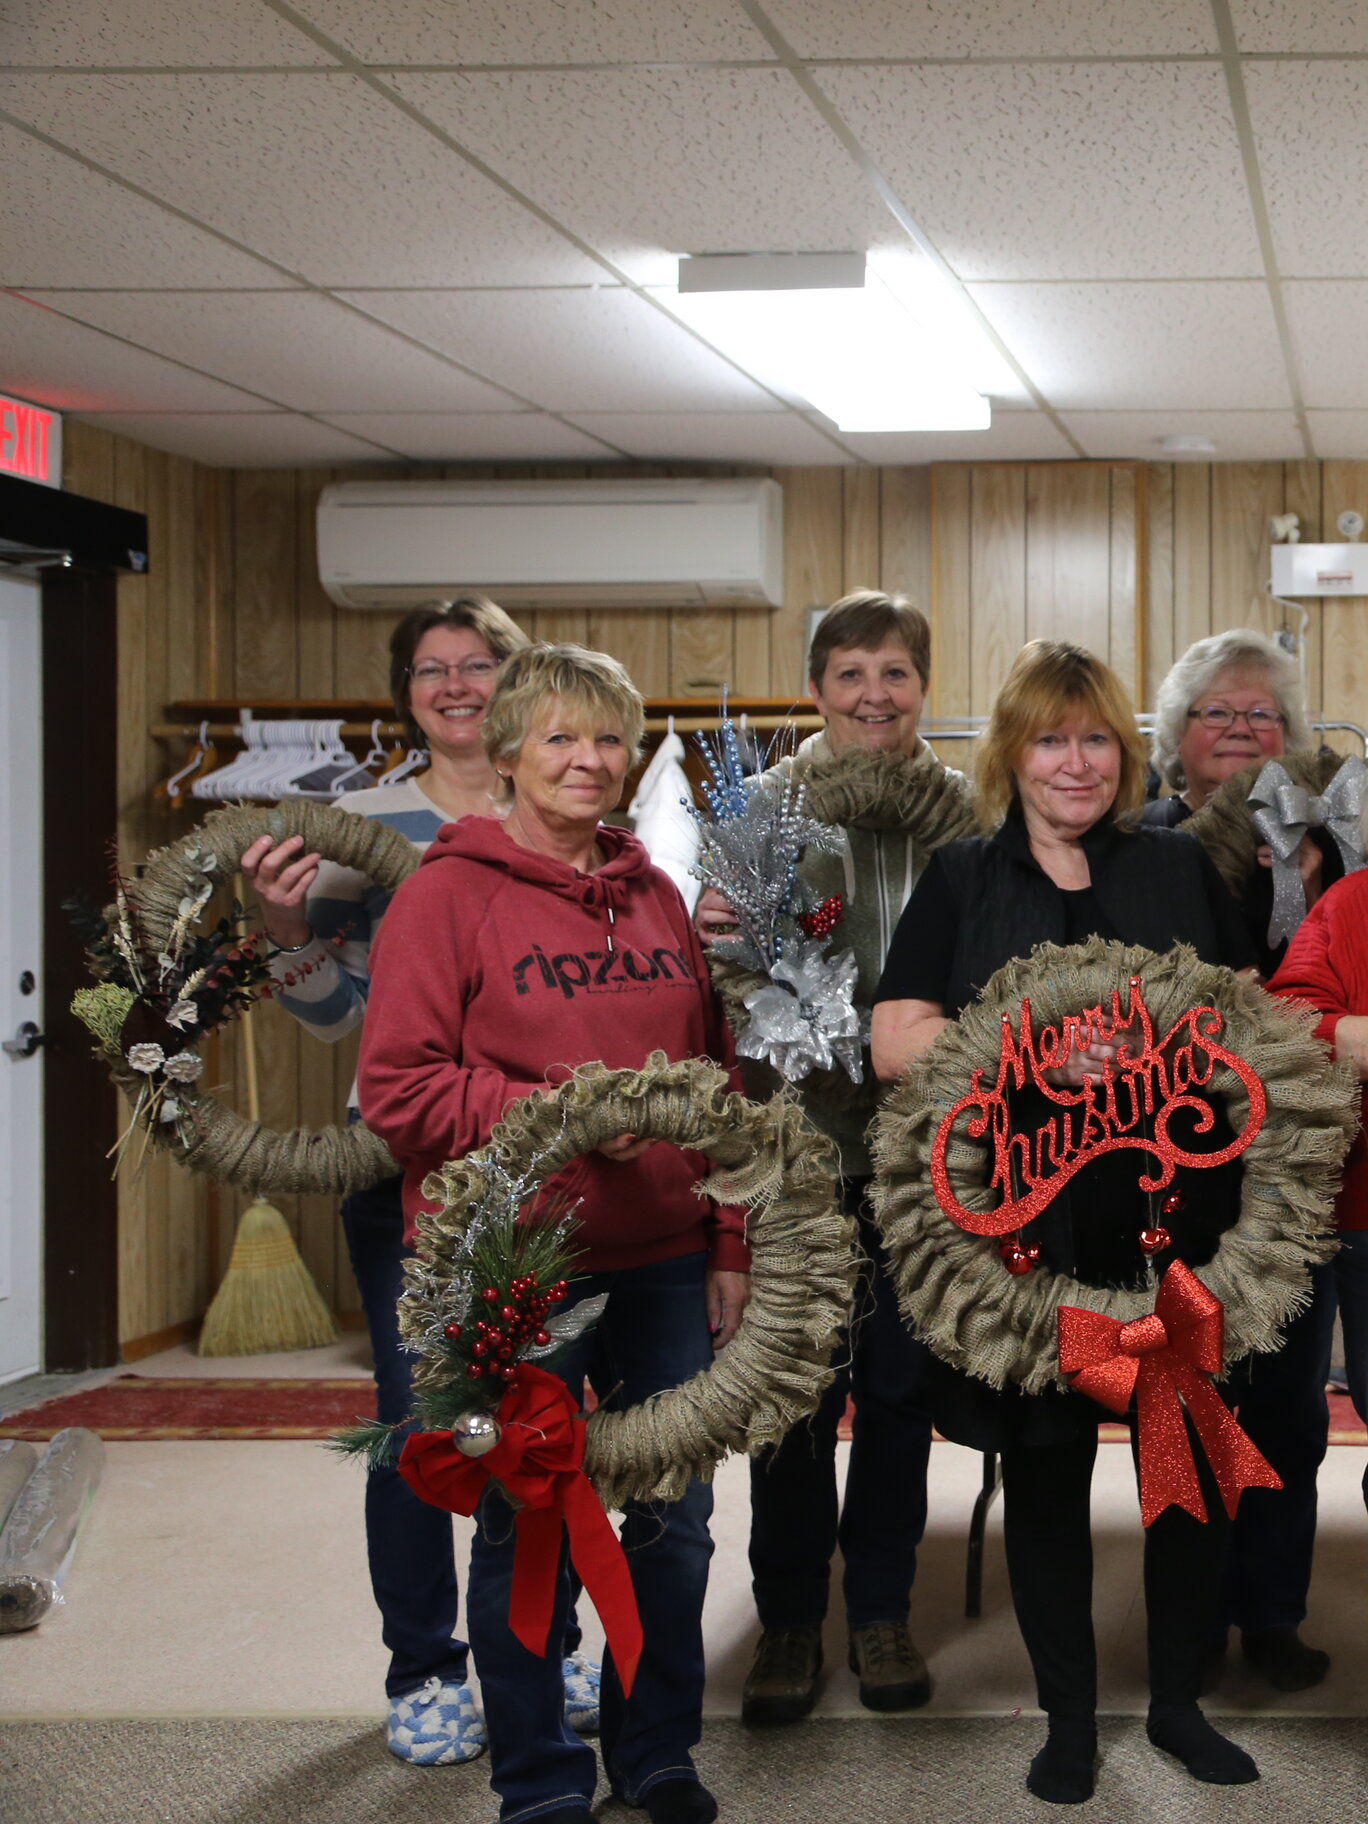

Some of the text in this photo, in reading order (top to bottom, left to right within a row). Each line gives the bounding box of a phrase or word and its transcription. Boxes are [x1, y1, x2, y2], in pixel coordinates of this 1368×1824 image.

[0, 398, 53, 481] EXIT
[971, 975, 1154, 1106] Merry
[930, 1005, 1267, 1236] Christmas
